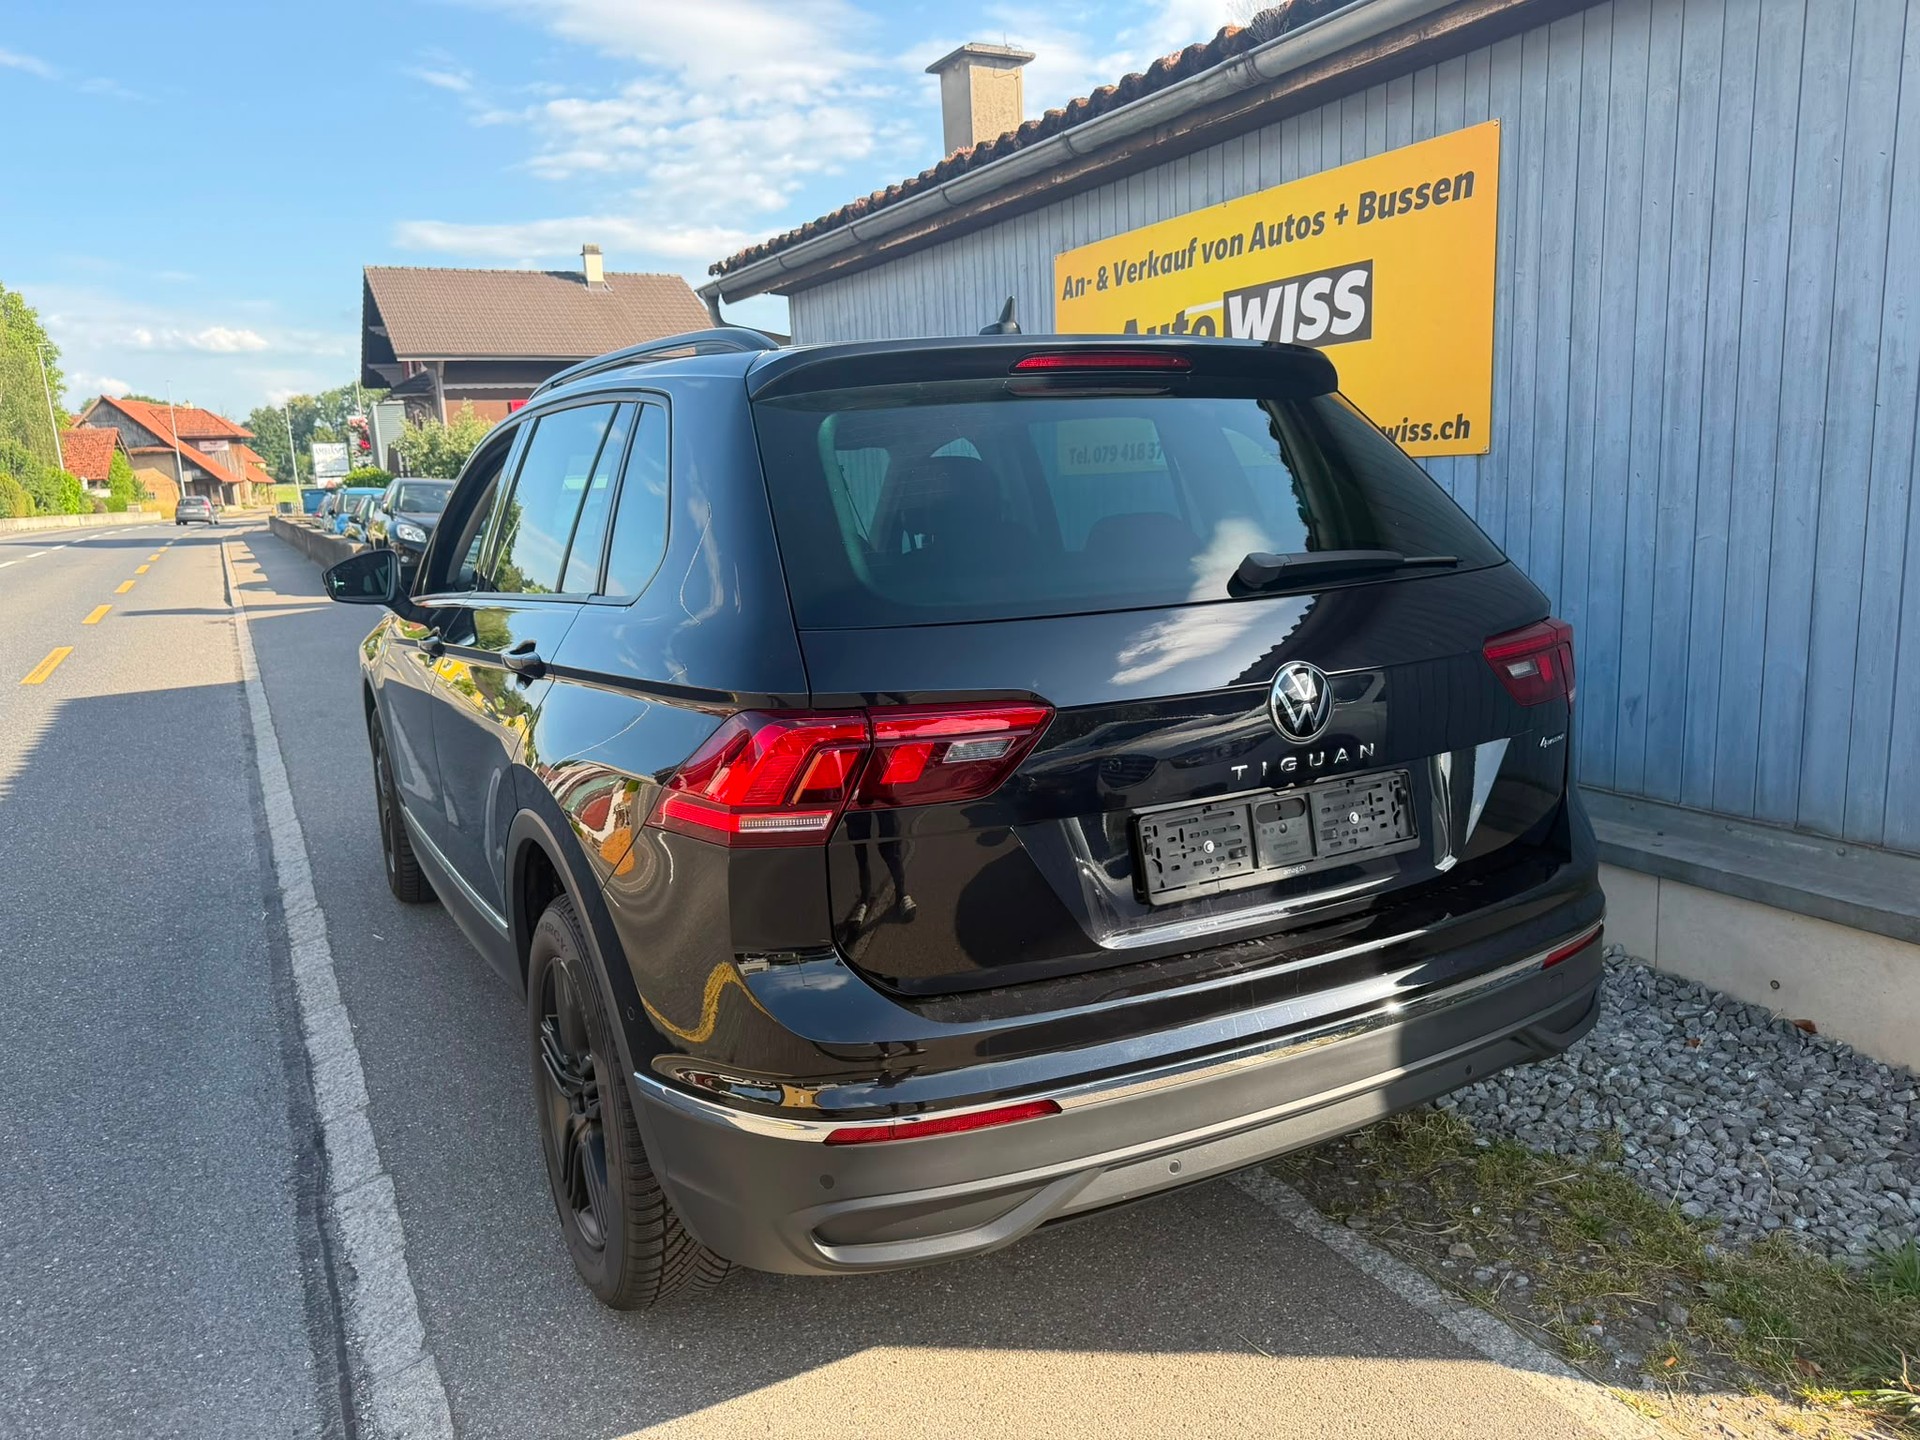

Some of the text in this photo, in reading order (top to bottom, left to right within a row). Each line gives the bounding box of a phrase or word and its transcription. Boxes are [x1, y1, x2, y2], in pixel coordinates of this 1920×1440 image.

[1062, 169, 1475, 301] An- & Verkauf von Autos + Bussen
[1228, 269, 1369, 343] WISS
[1068, 446, 1091, 466] Tel.
[1093, 444, 1118, 464] 079
[1230, 742, 1375, 781] TIGUAN
